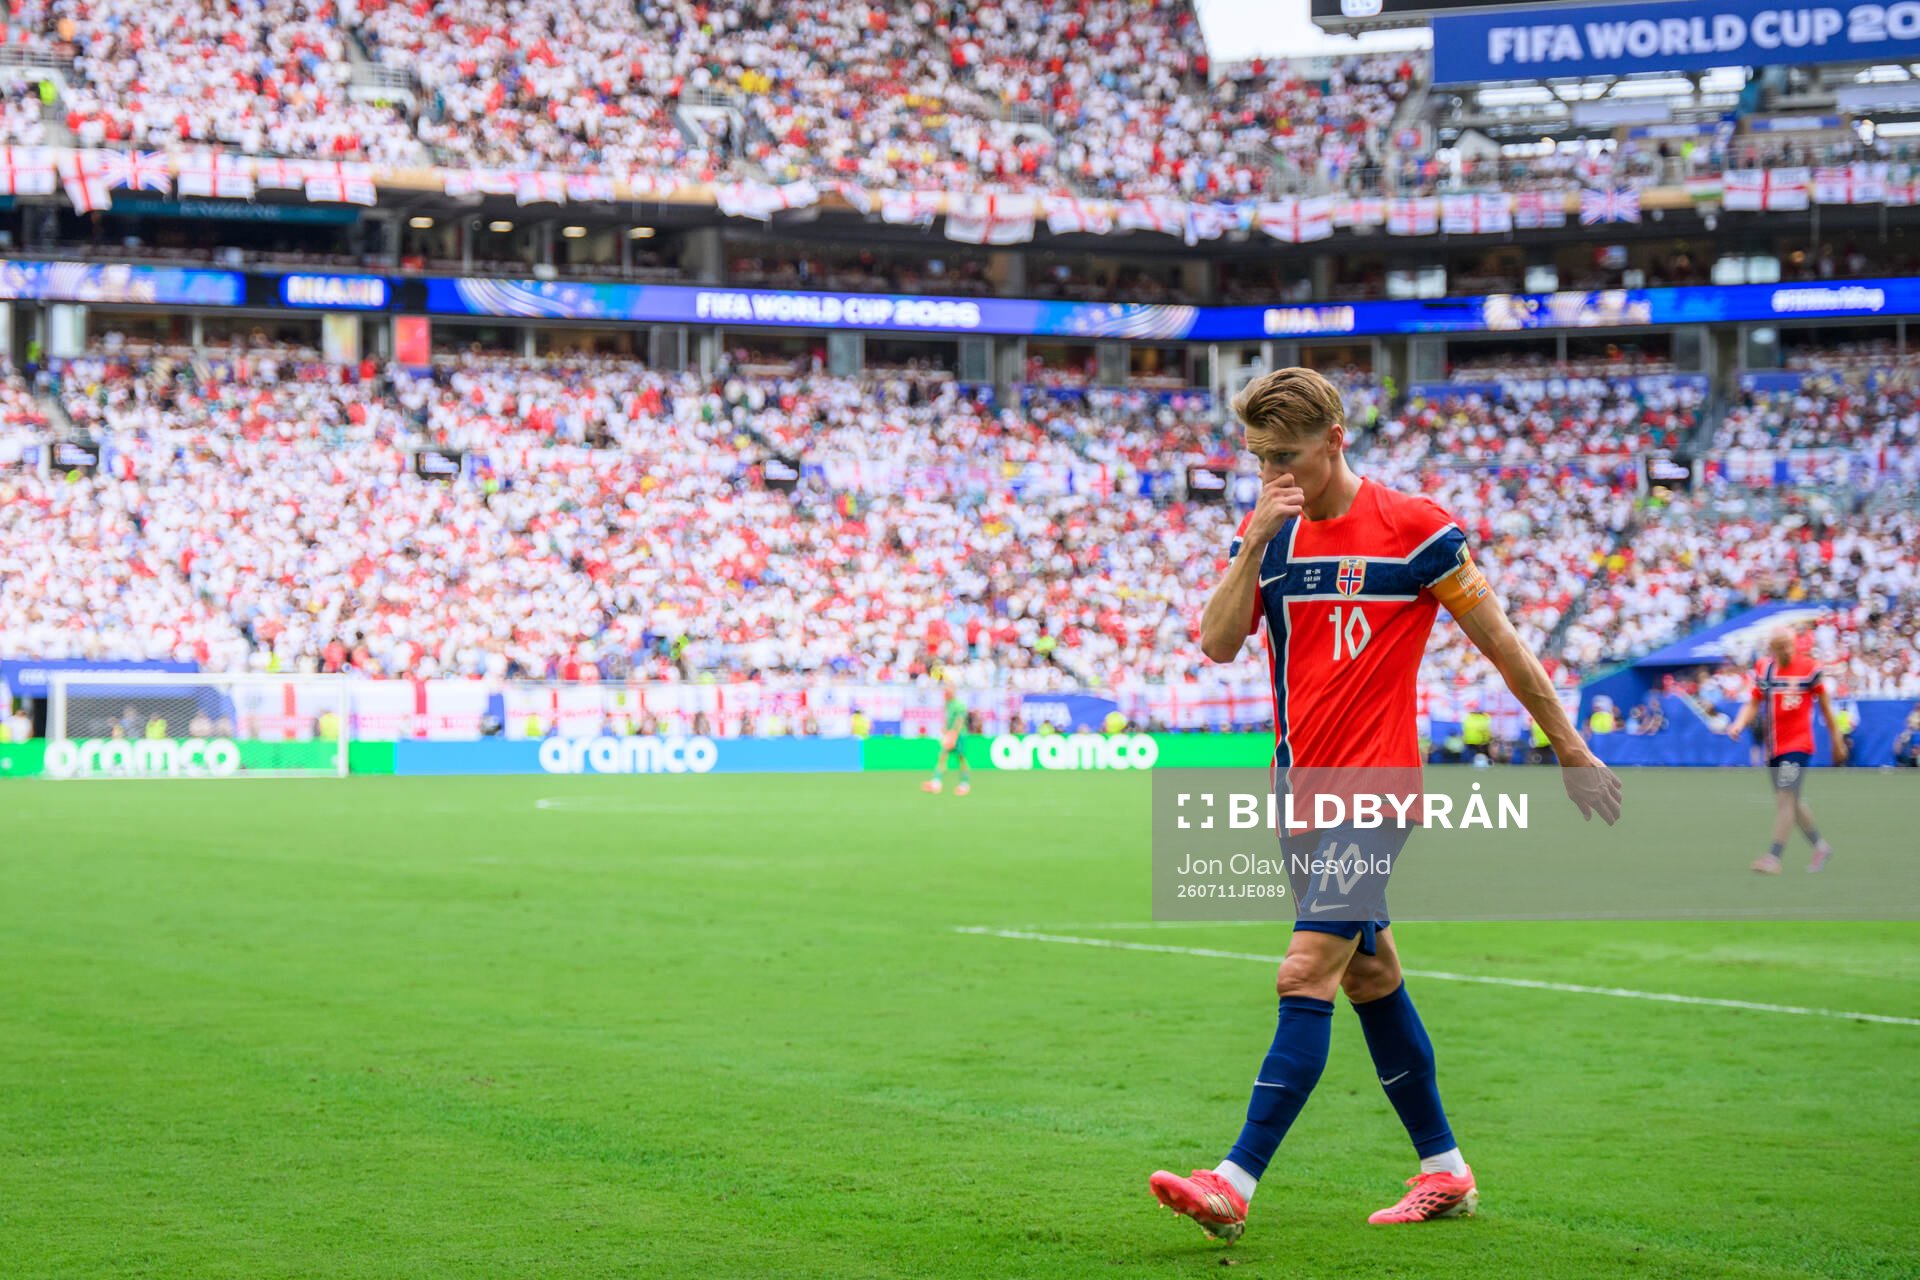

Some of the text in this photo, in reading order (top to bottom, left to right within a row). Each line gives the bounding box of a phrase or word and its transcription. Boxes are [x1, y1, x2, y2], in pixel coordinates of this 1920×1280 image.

[1488, 1, 1920, 64] FIFA WORLD CUP 20
[696, 292, 980, 328] FIFA WORLD CUP 2026
[1328, 606, 1372, 660] 10
[44, 738, 240, 777] aramco
[538, 736, 717, 773] aramco
[990, 733, 1159, 770] aramco
[1319, 842, 1364, 895] 10
